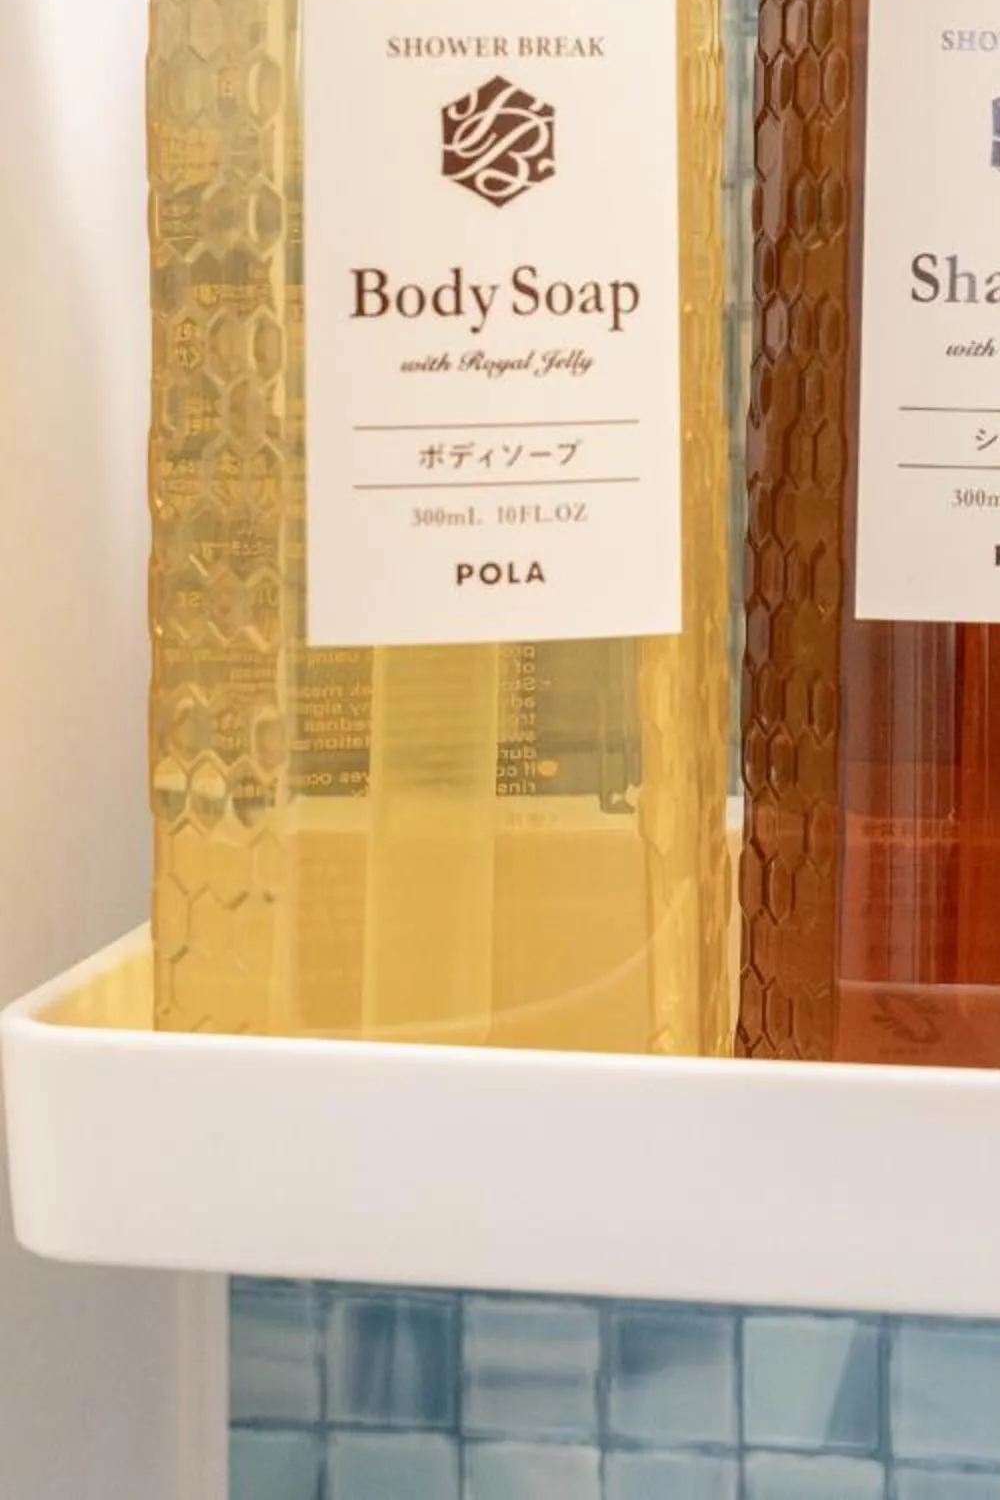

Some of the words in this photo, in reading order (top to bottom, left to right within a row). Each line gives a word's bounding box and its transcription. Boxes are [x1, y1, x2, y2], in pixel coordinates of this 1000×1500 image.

[387, 37, 508, 58] SHOWER
[518, 36, 604, 57] BREAK
[350, 267, 498, 334] Body
[512, 265, 640, 332] Soap
[946, 338, 995, 357] with
[400, 351, 452, 372] with
[457, 350, 533, 378] Royal
[533, 348, 596, 378] Jelly
[419, 438, 583, 469] ボディソープ
[411, 506, 484, 527] 300mL
[456, 561, 545, 586] POLA
